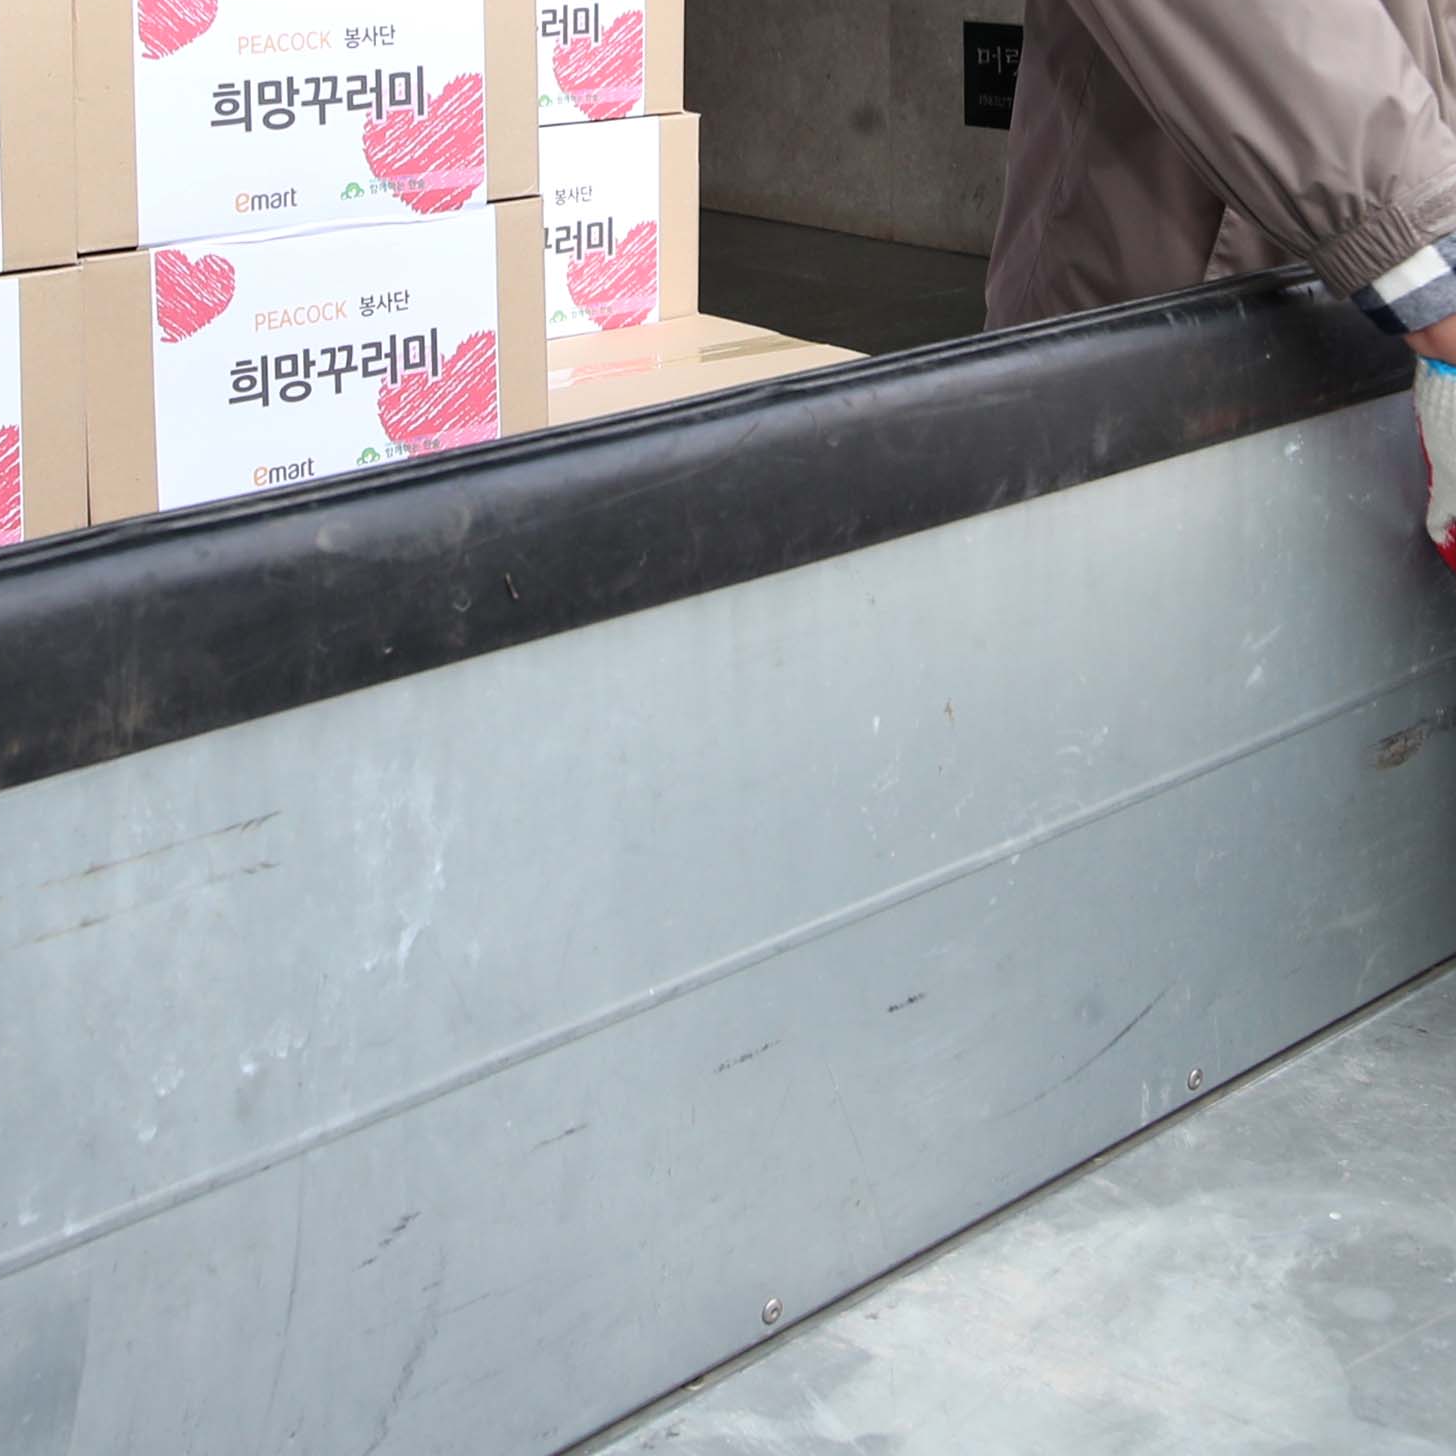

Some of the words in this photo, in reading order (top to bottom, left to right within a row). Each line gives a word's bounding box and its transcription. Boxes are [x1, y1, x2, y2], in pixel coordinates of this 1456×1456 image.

[237, 30, 332, 56] PEACOCK
[343, 24, 397, 51] 봉사단
[209, 64, 427, 134] 희망꾸러미
[234, 185, 299, 215] emart
[554, 184, 593, 207] 봉사단
[254, 300, 348, 334] PEACOCK
[358, 288, 411, 318] 봉사단
[227, 327, 442, 410] 희망꾸러미
[252, 456, 316, 488] emart
